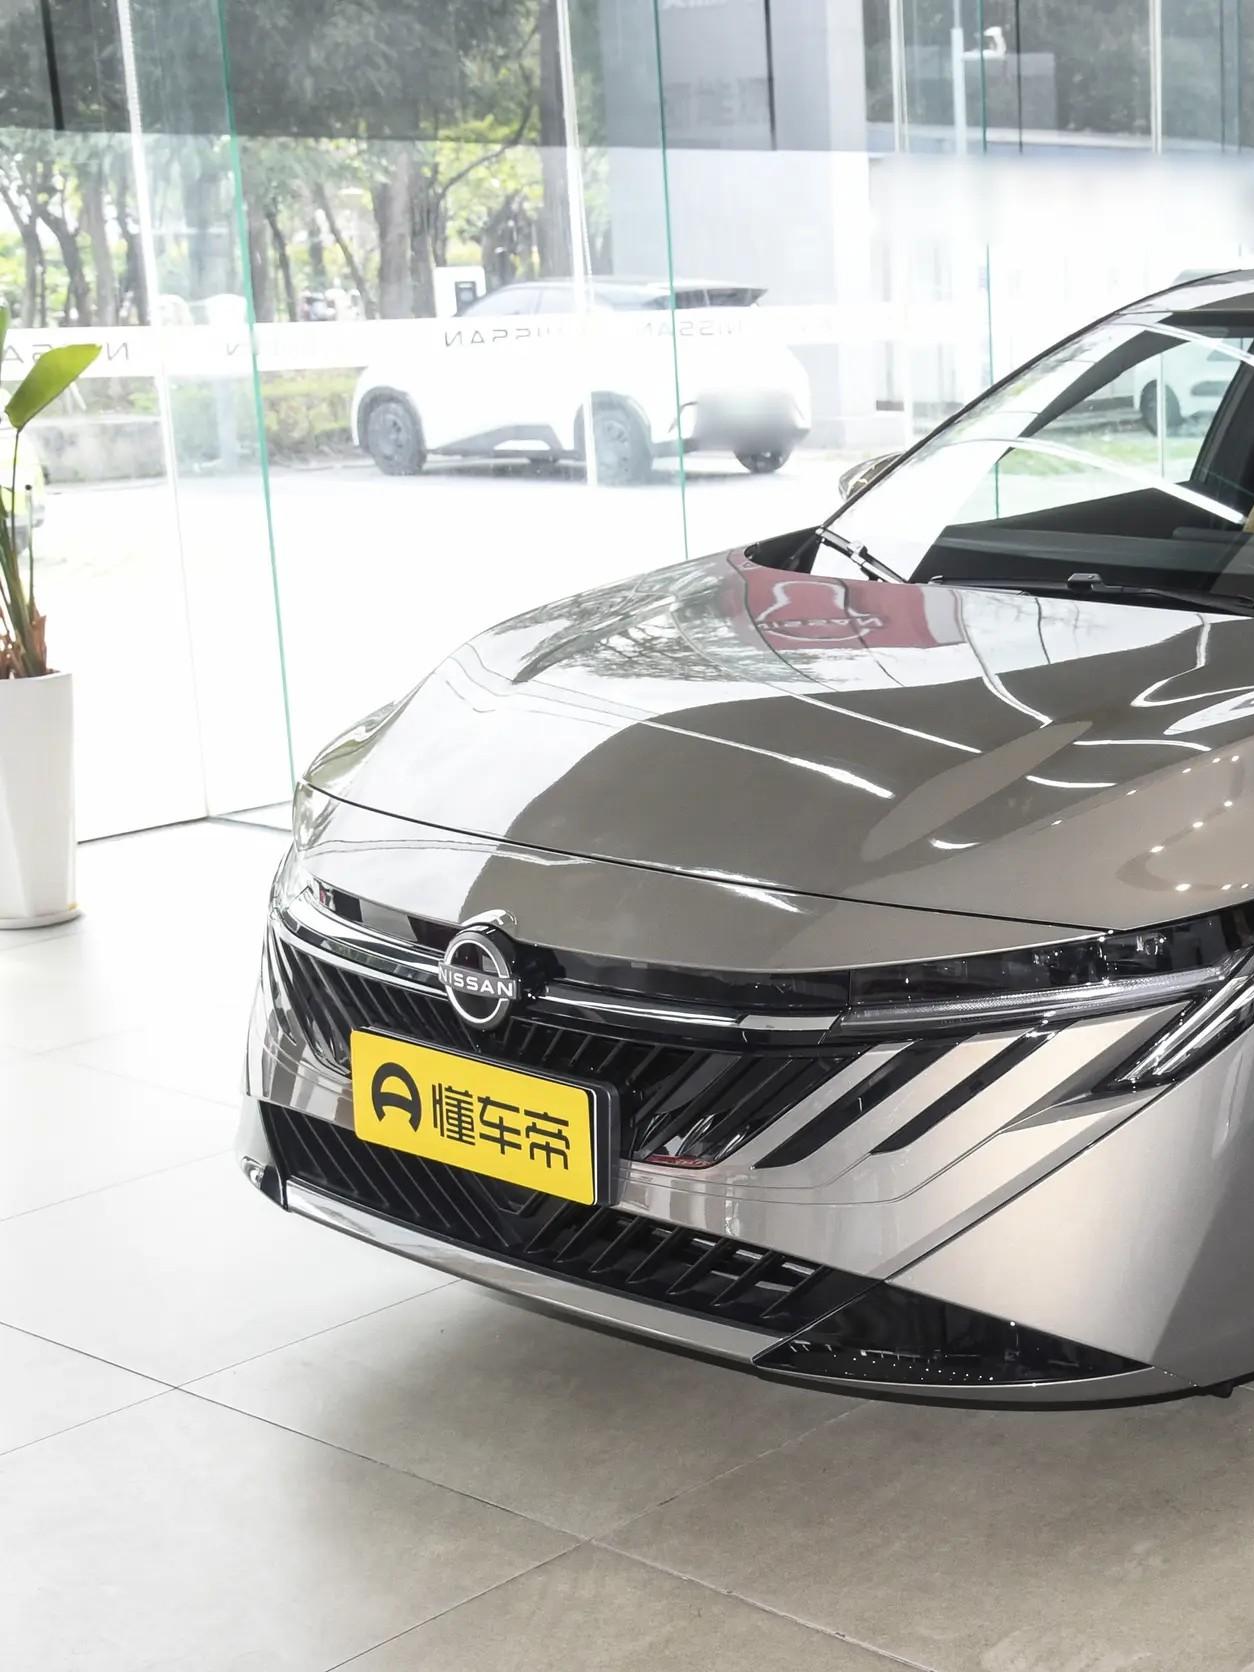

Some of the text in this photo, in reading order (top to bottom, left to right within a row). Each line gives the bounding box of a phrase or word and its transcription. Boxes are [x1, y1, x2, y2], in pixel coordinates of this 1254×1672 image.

[439, 966, 513, 997] NISSAN
[431, 1083, 571, 1170] 懂车帝
